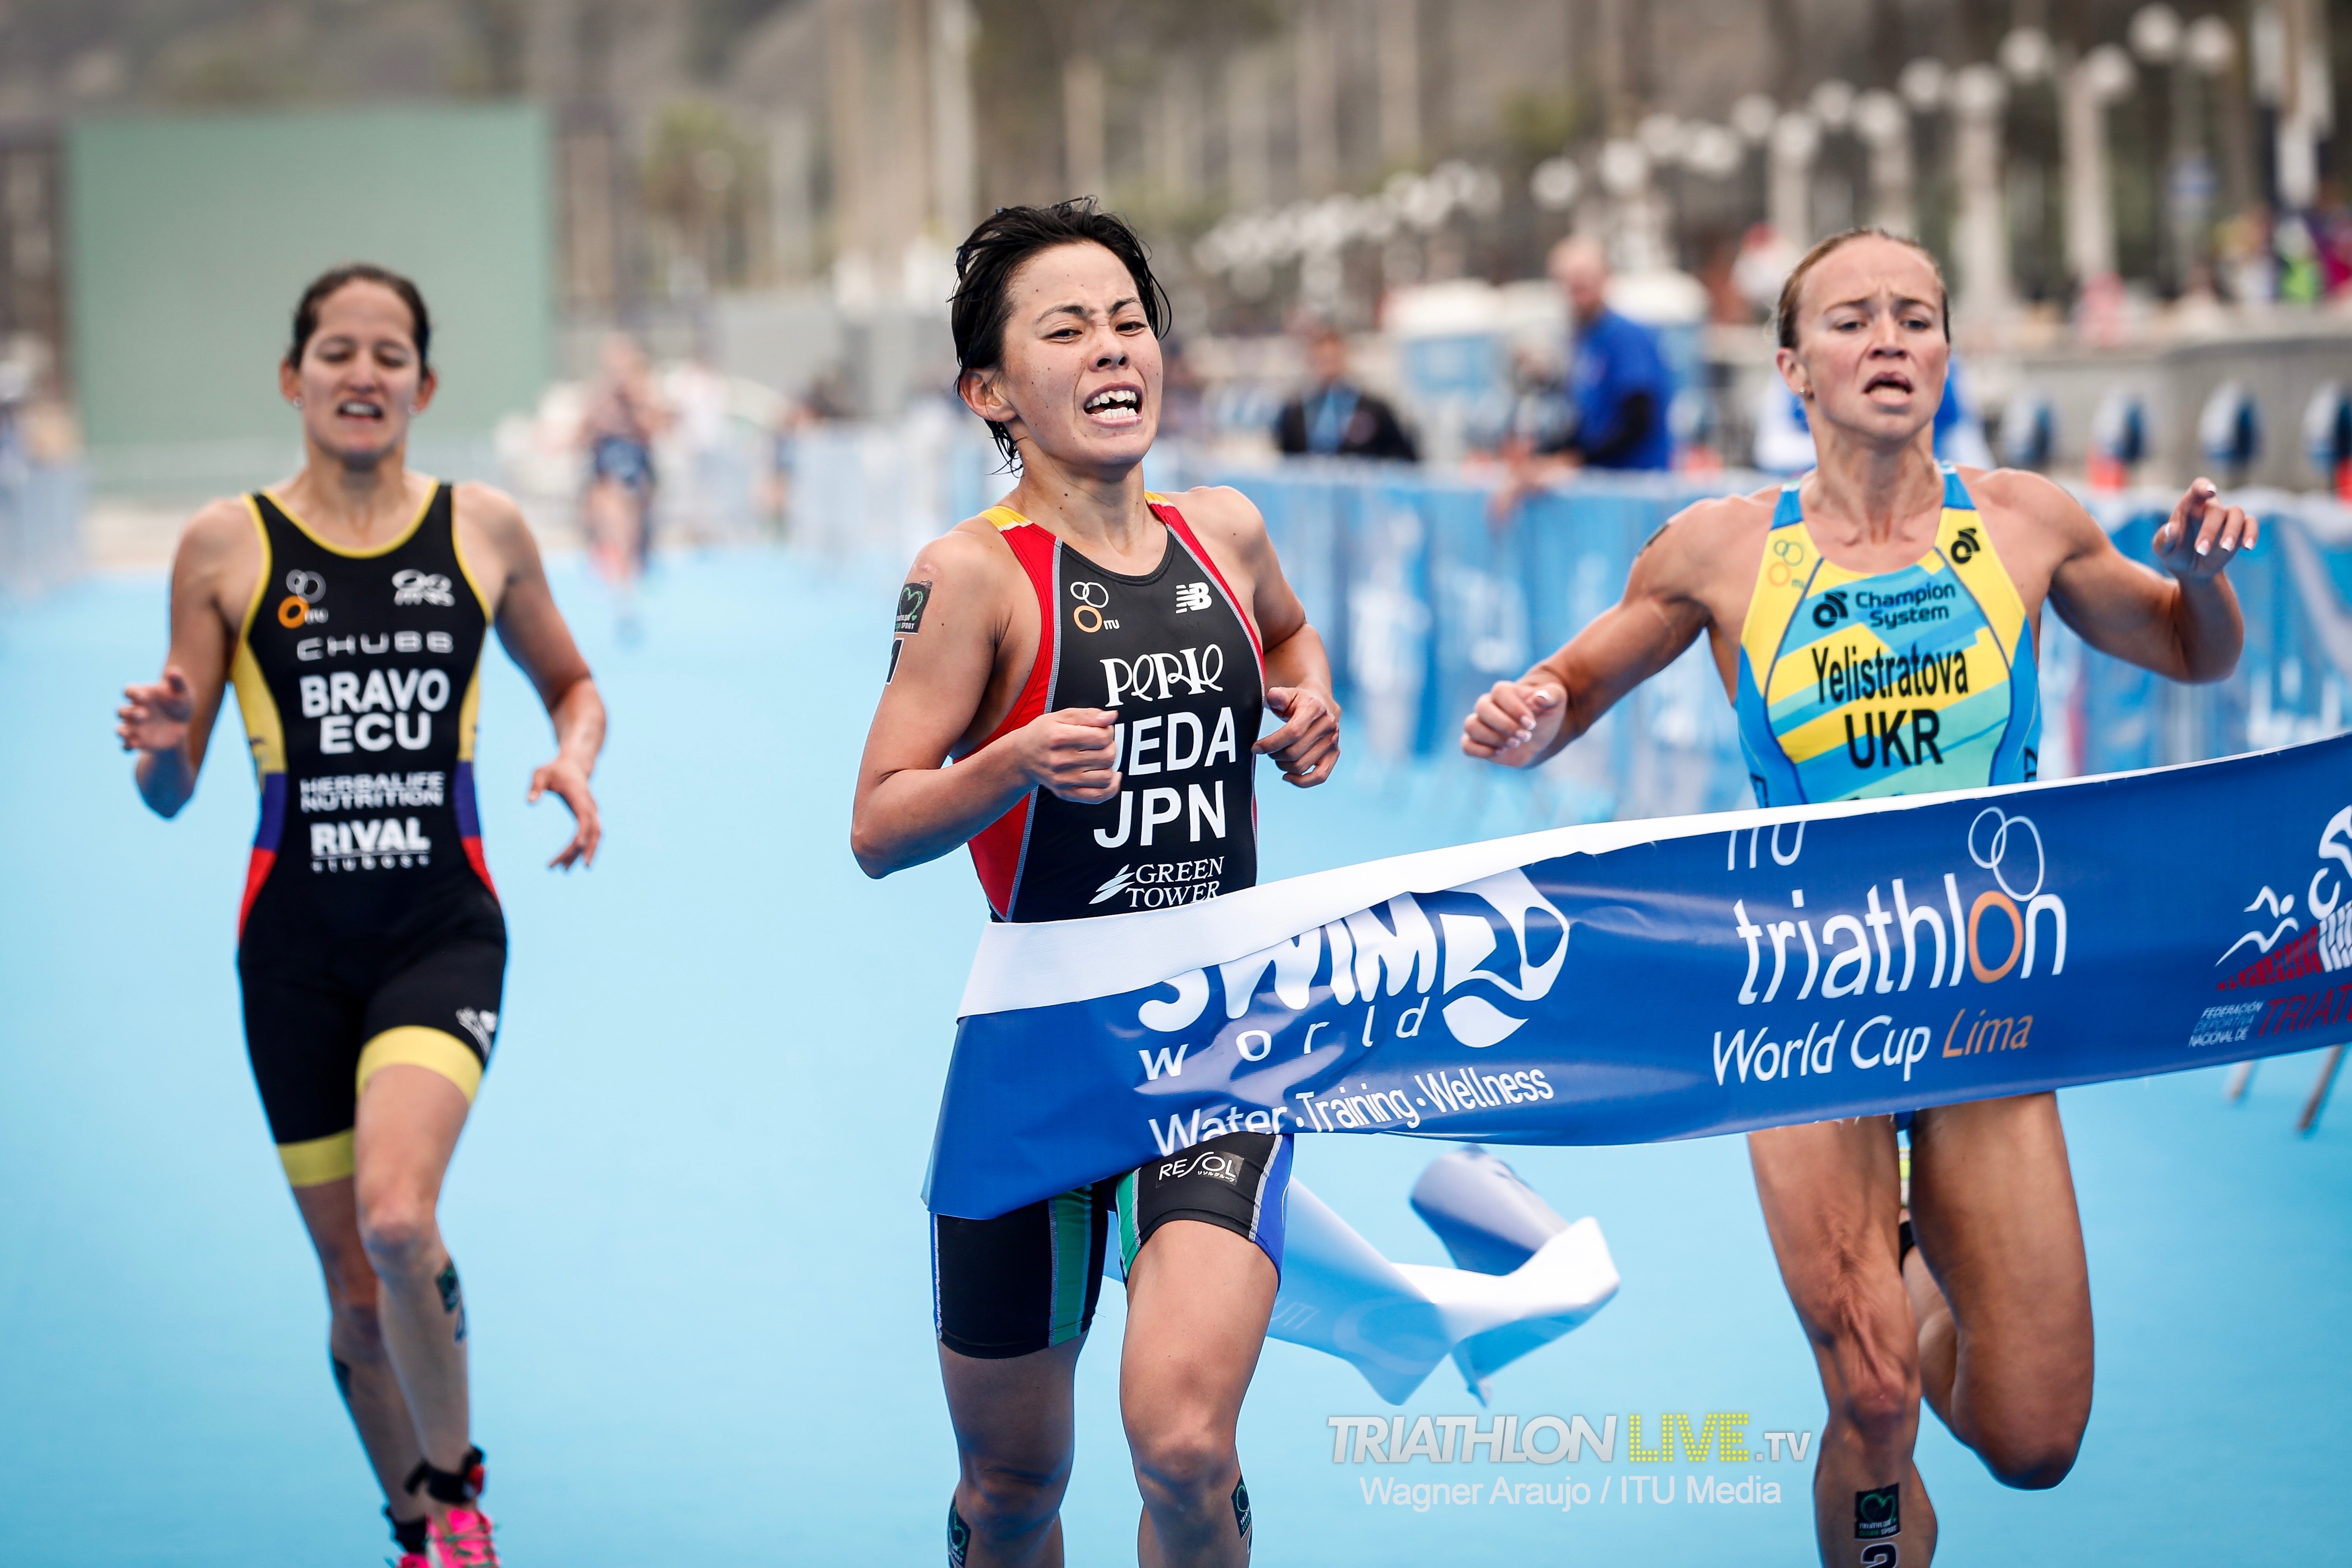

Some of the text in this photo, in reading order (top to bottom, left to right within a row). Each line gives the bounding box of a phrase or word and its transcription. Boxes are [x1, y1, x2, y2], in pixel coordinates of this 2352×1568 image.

[1856, 582, 1956, 609] Champion
[1104, 619, 1120, 630] ITU
[1870, 604, 1949, 629] System
[297, 631, 454, 661] CHUBB
[1812, 641, 1969, 705] Yelistratova
[300, 668, 451, 718] BRAVO
[320, 711, 431, 754] ECU
[1844, 709, 1943, 769] UKR
[300, 771, 446, 794] HERBALIFE
[300, 789, 444, 813] NUTRITION
[1094, 780, 1226, 848] JPN
[311, 817, 430, 856] RIVAL
[1132, 856, 1224, 884] GREEN
[1126, 879, 1220, 908] TOWER
[1733, 873, 2067, 1005] triathlon
[1713, 1008, 2033, 1086] World Cup Lima
[1159, 1152, 1236, 1180] RESOL
